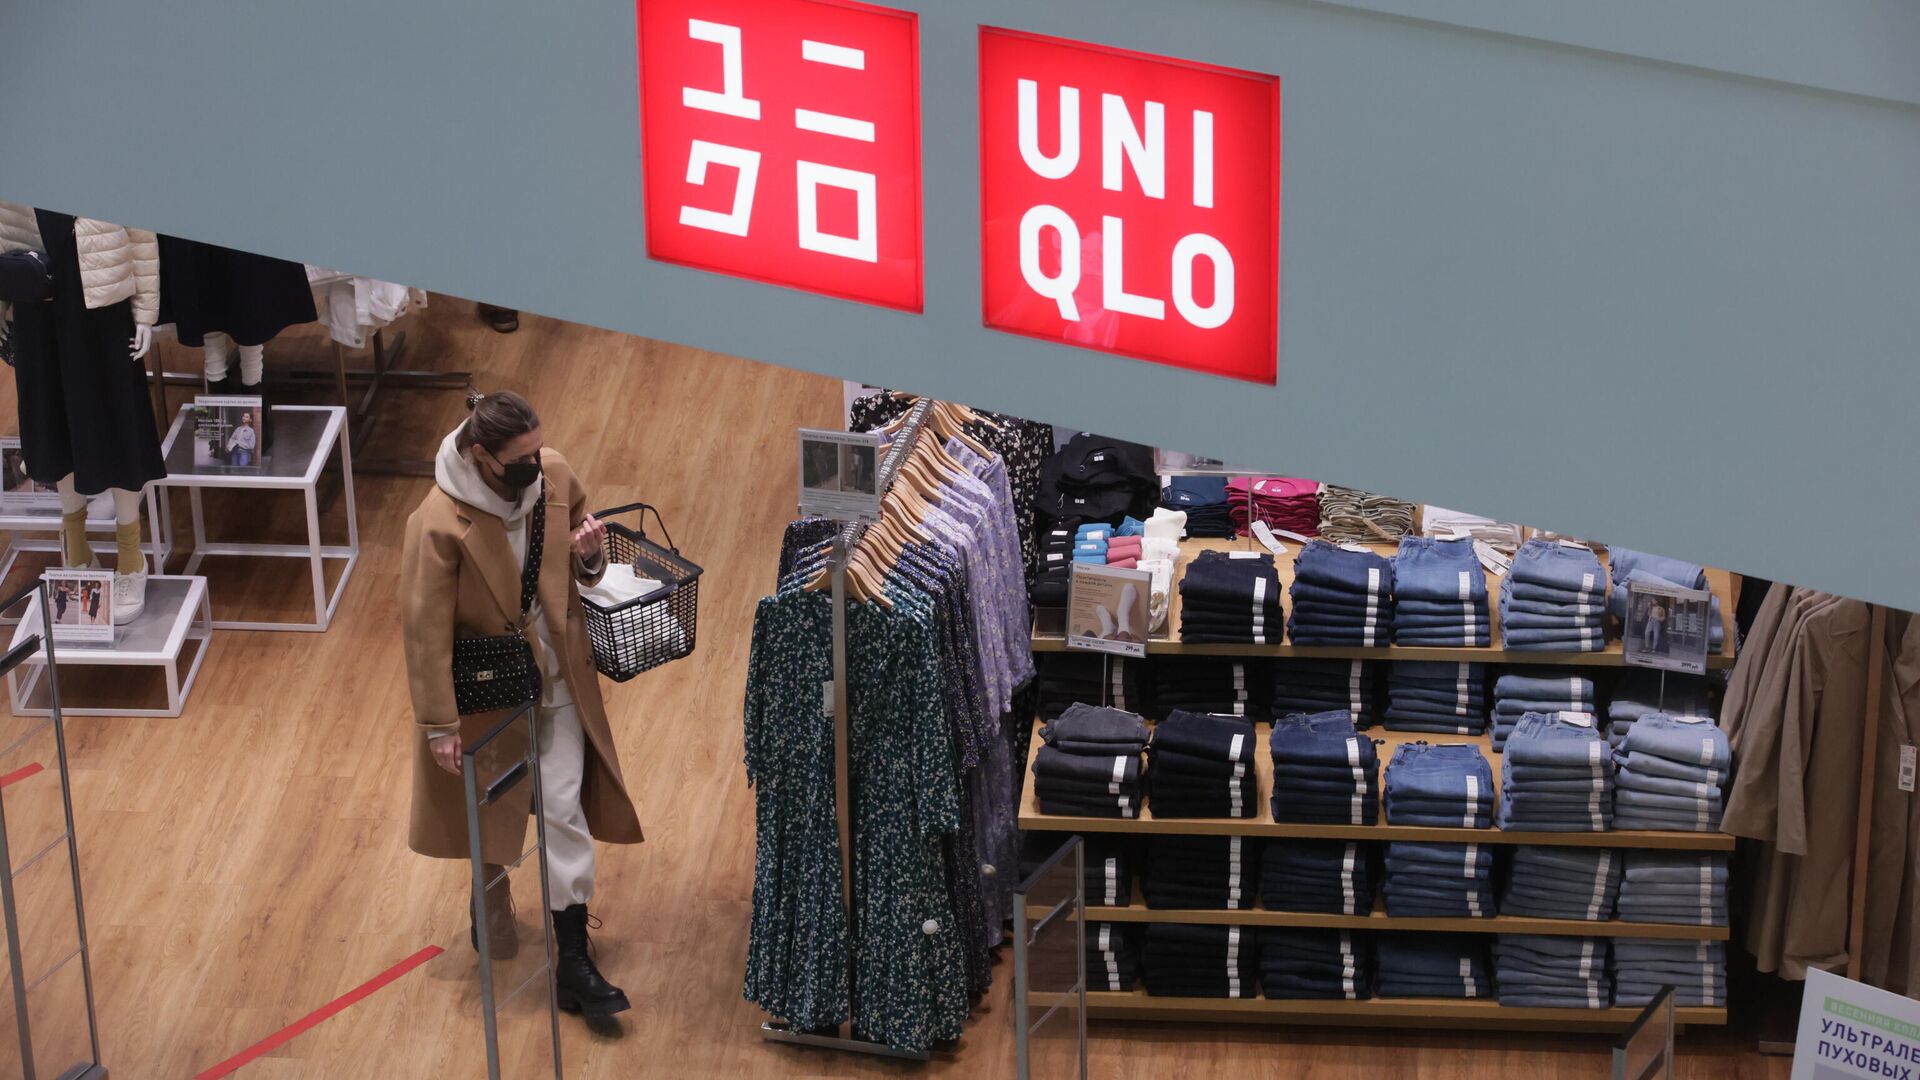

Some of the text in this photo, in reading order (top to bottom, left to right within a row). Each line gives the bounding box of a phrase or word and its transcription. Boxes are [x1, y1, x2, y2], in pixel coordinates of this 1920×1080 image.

[1017, 78, 1213, 209] UNI
[1019, 204, 1235, 329] QLO
[1830, 1001, 1890, 1028] ВЕСЕННЯЯ
[1818, 1040, 1911, 1080] ПУХОВЫХ
